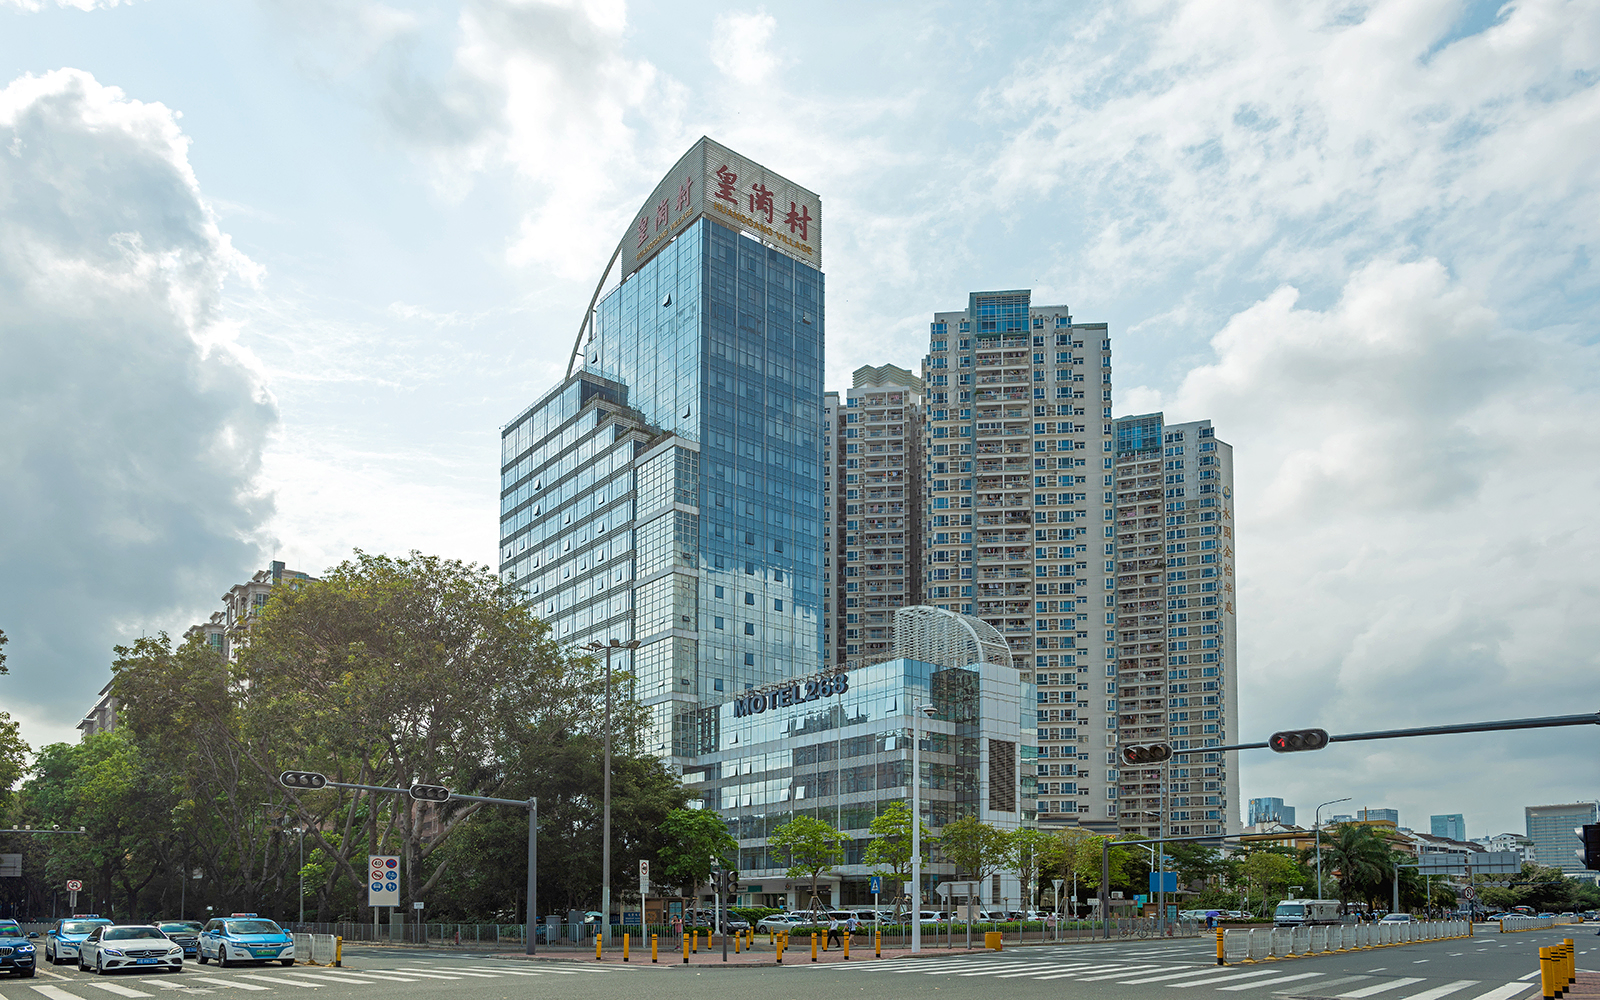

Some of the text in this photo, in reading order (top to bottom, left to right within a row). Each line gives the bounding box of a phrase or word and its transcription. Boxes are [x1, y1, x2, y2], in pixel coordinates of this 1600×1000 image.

[670, 207, 693, 231] VILLAGE
[713, 201, 813, 256] HUANGGANG VILLAGE
